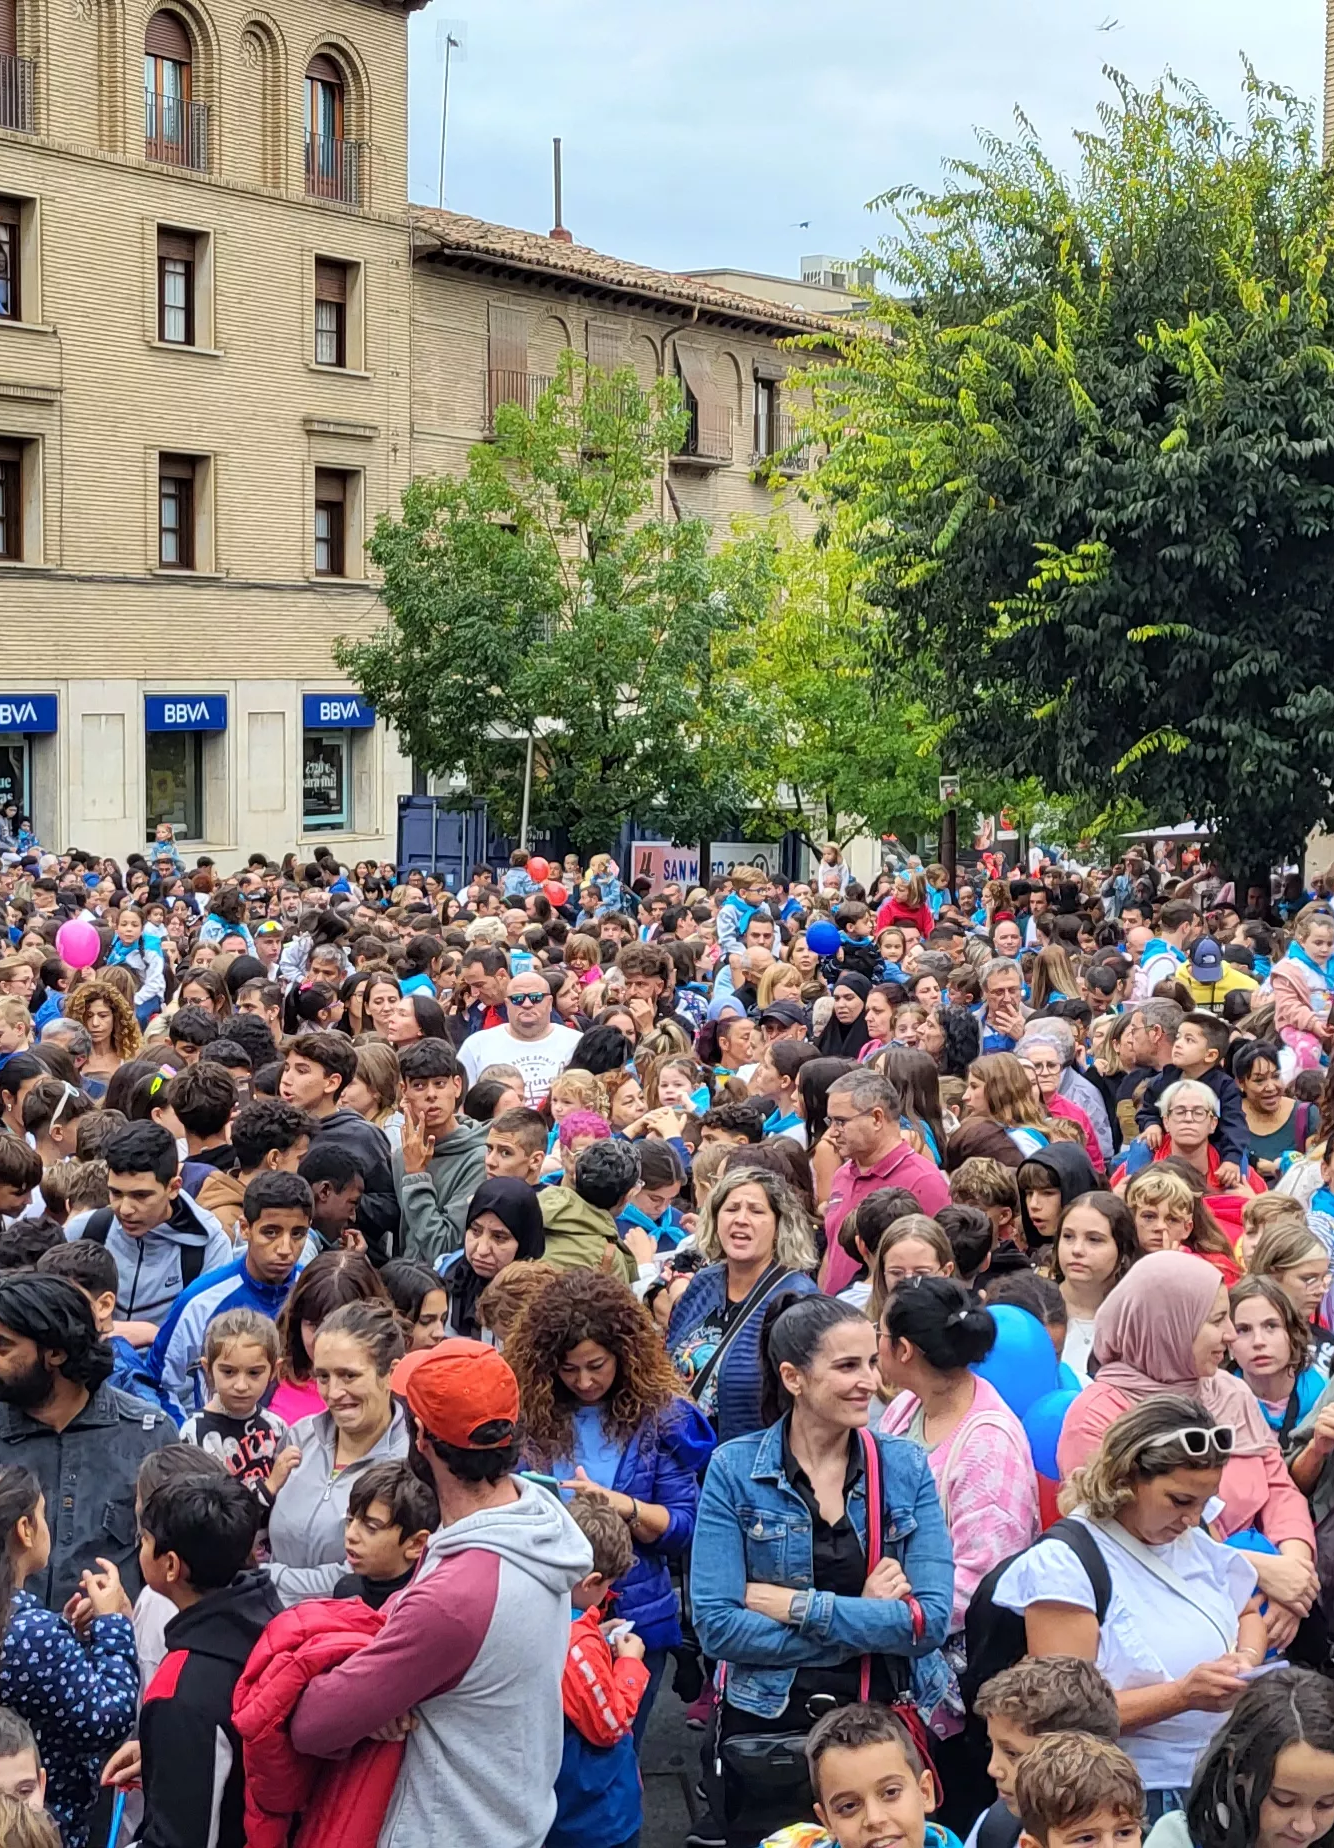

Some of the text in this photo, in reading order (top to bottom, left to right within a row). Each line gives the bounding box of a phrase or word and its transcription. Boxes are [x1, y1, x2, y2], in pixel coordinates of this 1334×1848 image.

[164, 701, 210, 723] BBVA
[320, 700, 360, 721] BBVA
[663, 859, 687, 881] SAN
[689, 860, 725, 881] MEO
